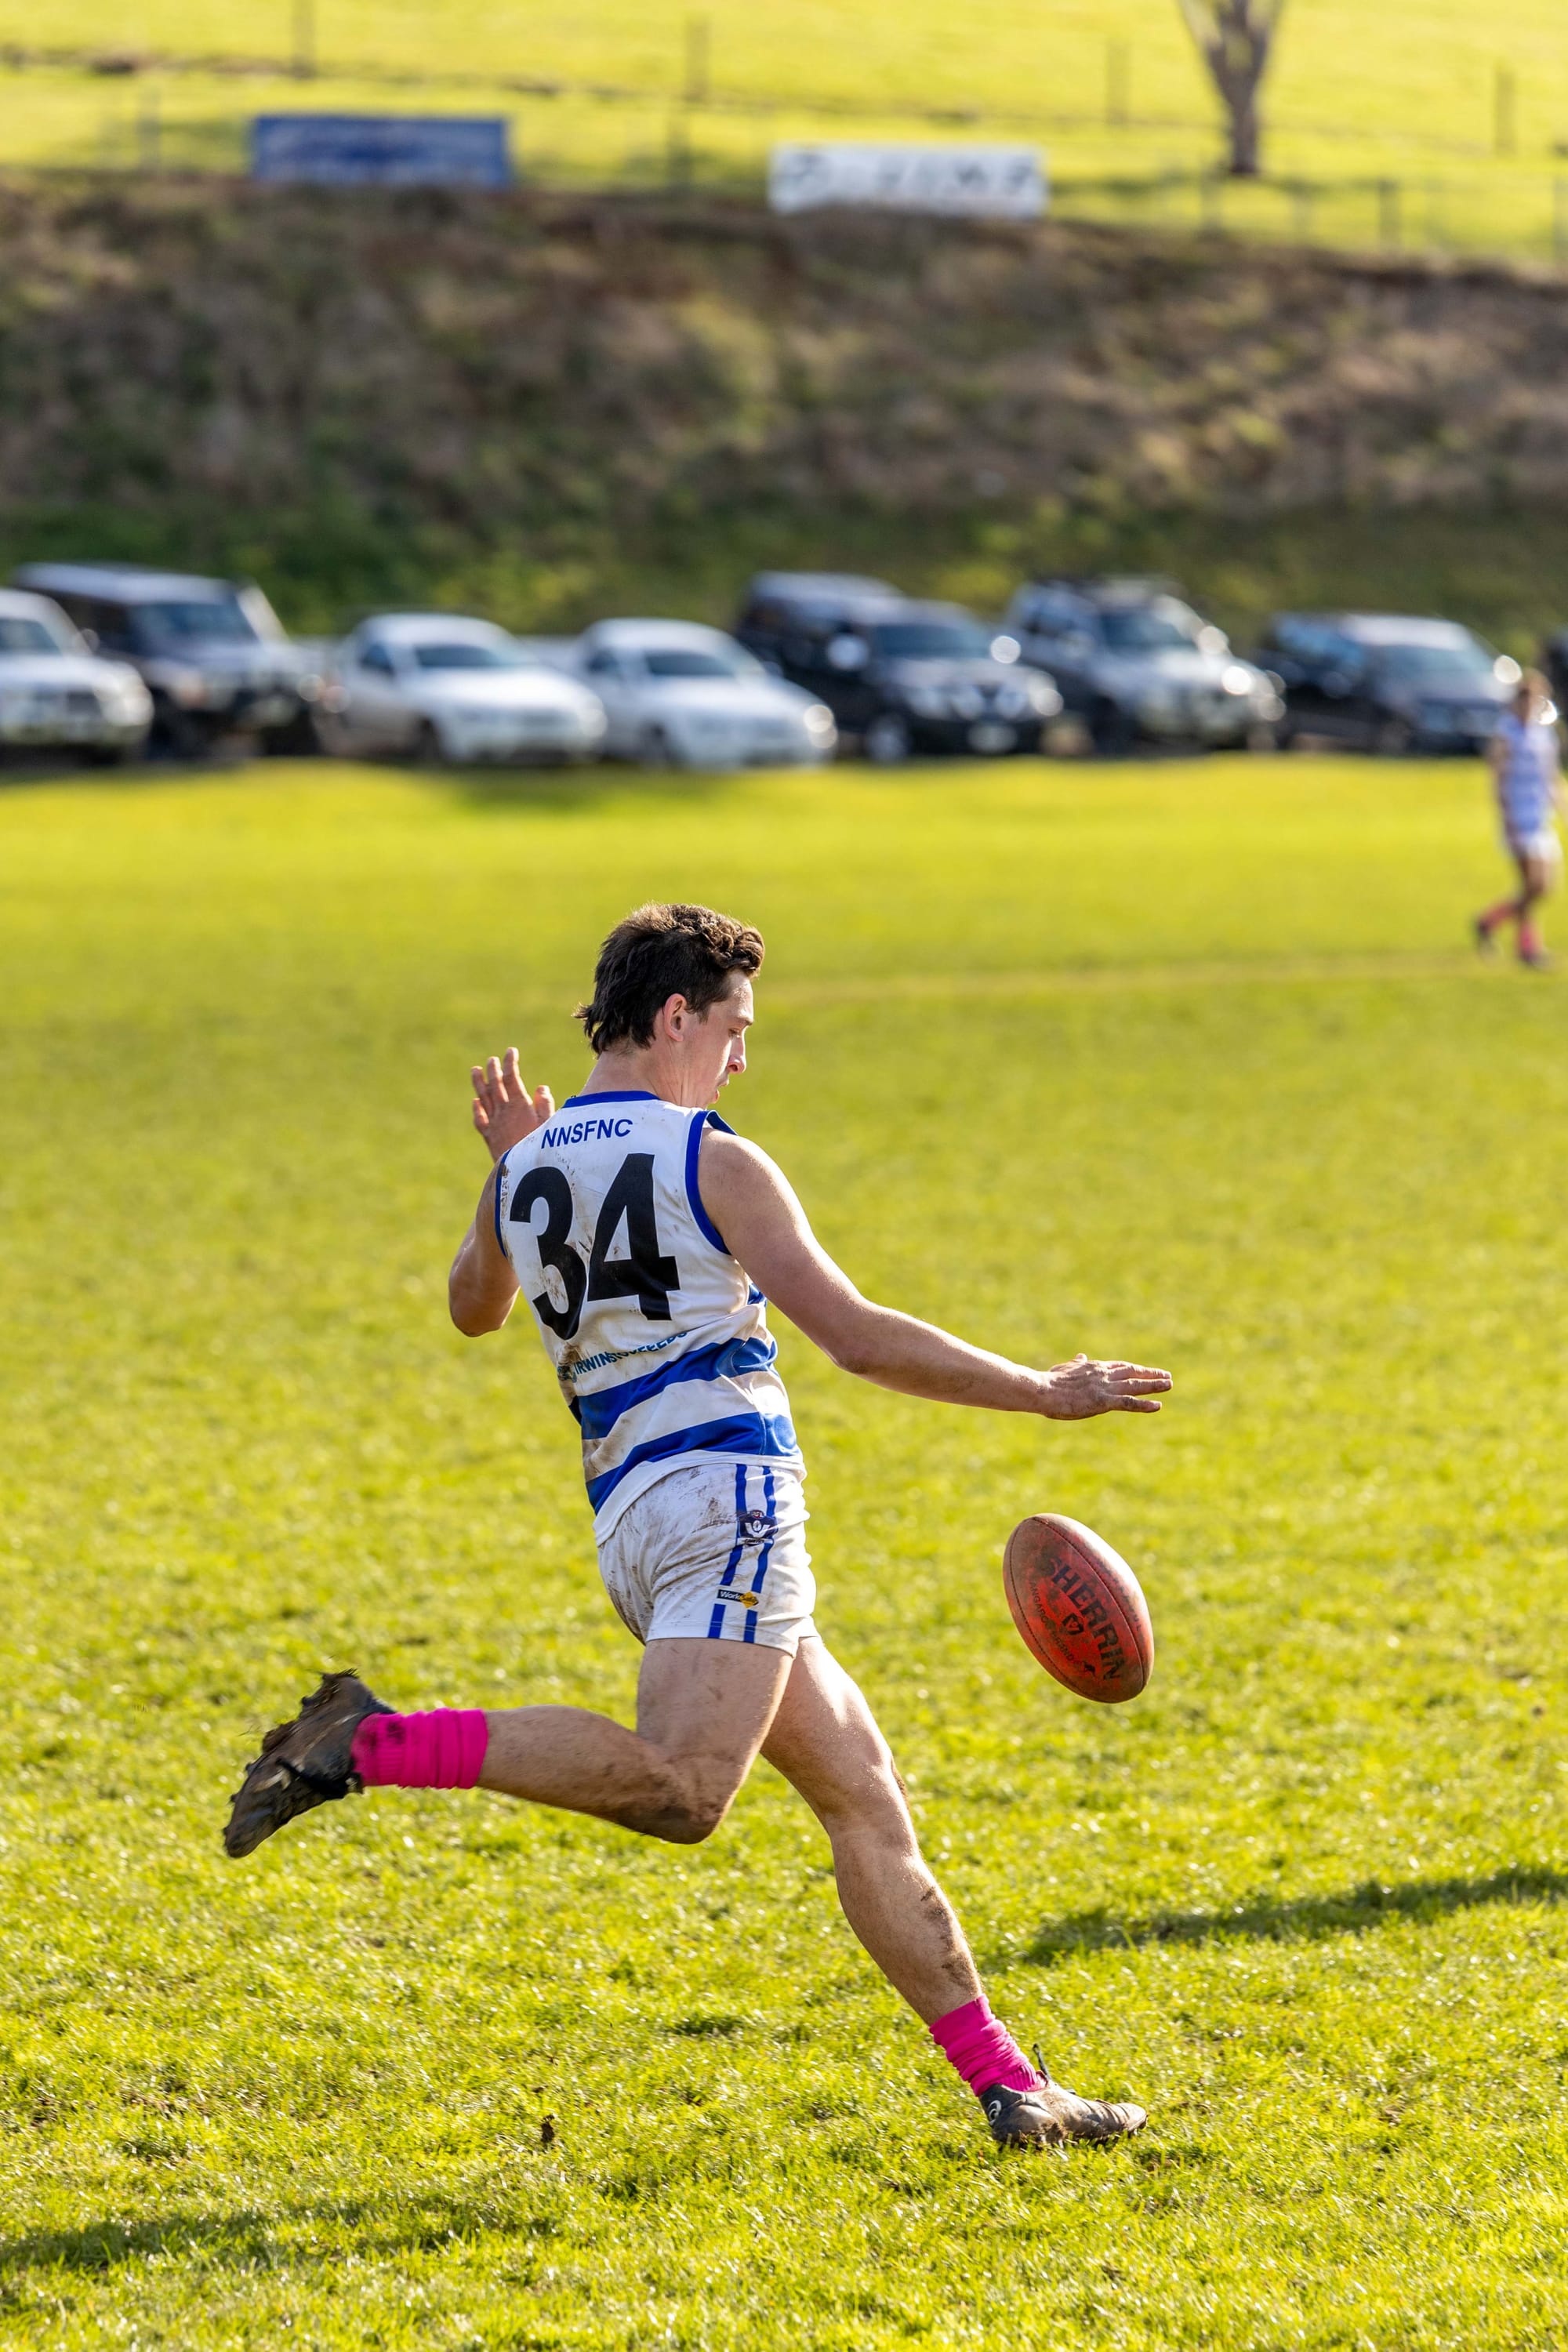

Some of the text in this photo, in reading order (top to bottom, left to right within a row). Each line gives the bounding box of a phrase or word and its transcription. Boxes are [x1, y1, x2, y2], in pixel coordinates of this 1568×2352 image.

[540, 1118, 633, 1149] NNSFNC
[510, 1152, 681, 1341] 34
[1046, 1556, 1125, 1681] SHERRIN
